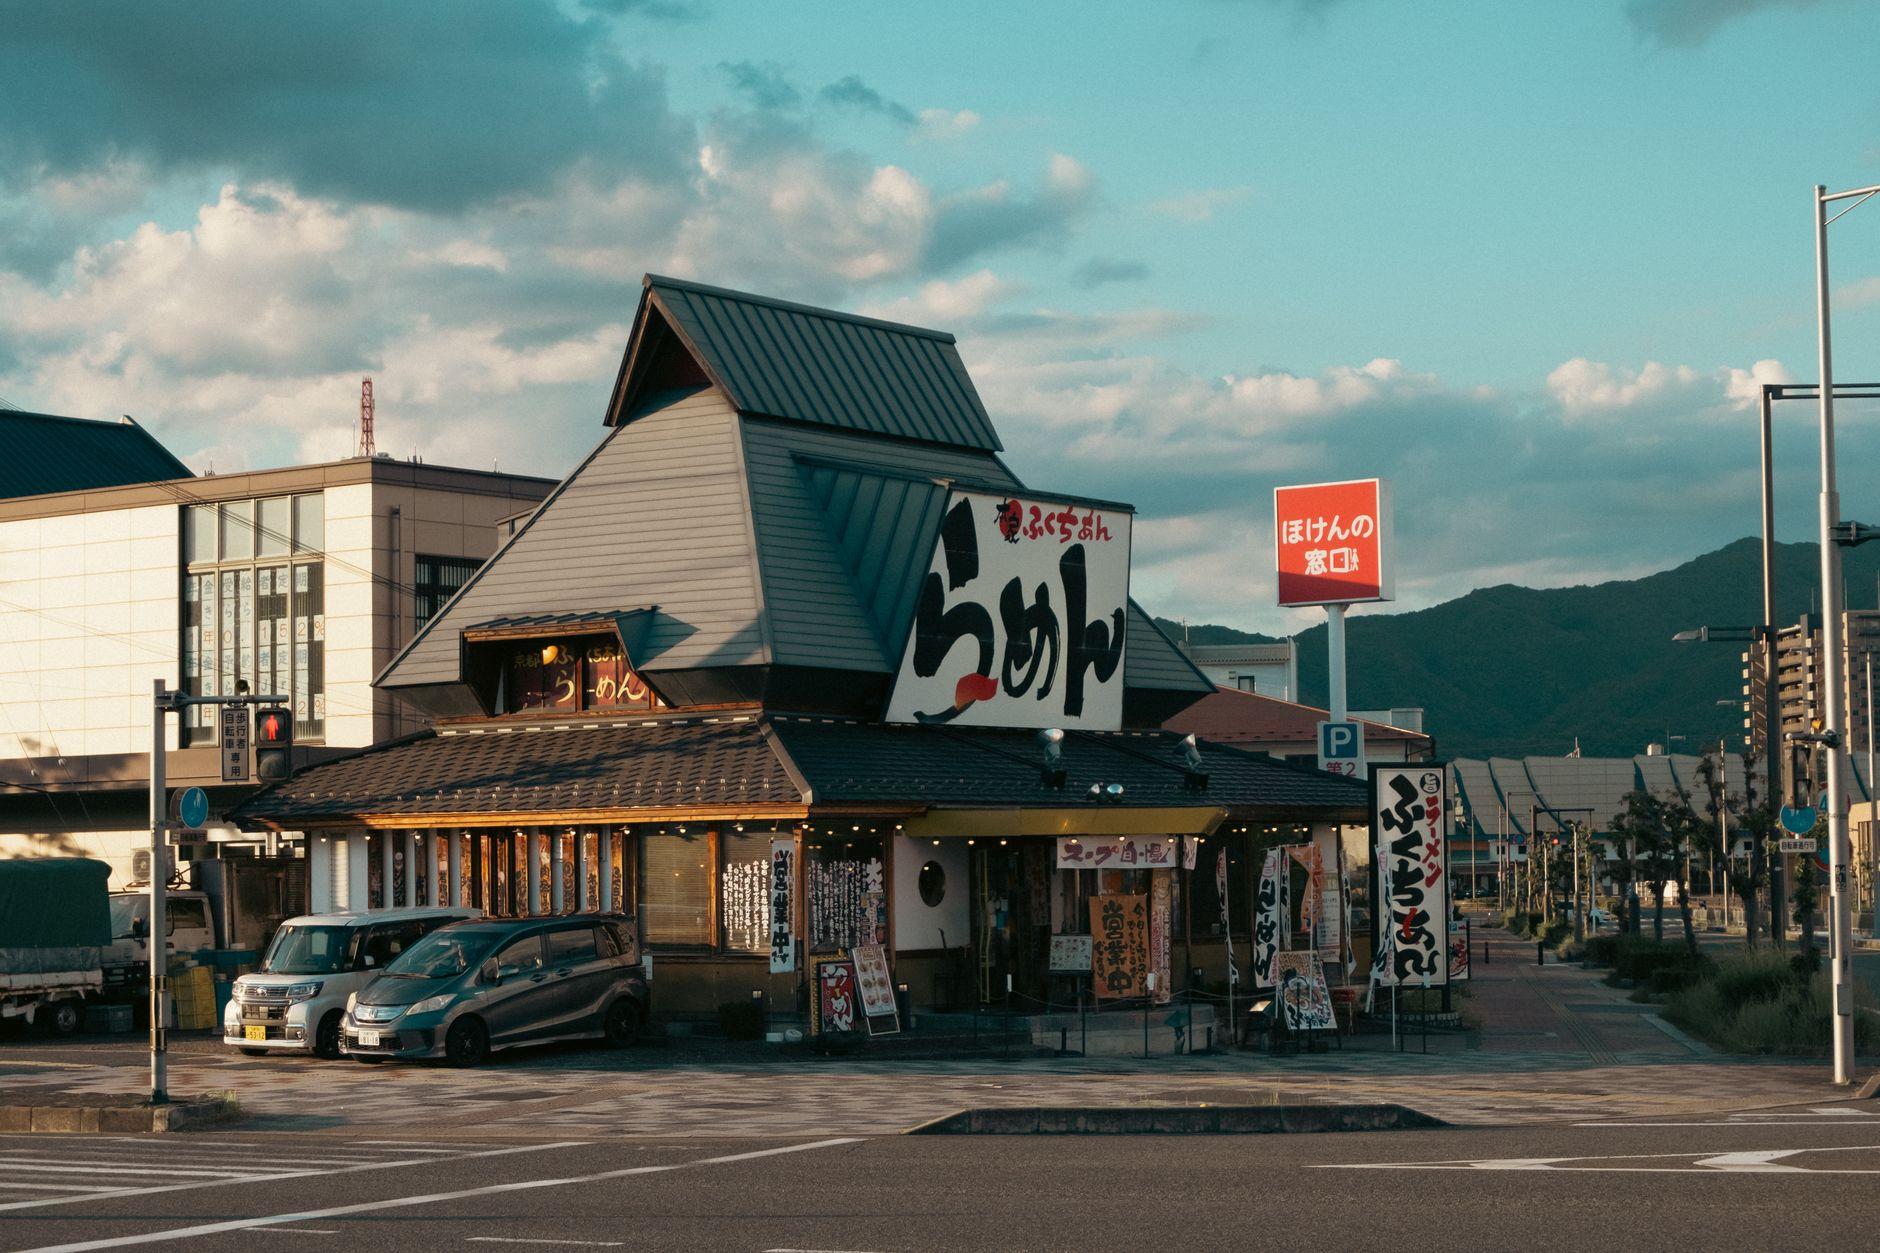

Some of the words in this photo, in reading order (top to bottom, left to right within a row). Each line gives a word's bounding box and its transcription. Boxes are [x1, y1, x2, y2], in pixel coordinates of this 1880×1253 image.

[1282, 513, 1374, 544] ほけんの
[1305, 547, 1352, 576] 窓口
[555, 669, 646, 703] らーめん
[225, 713, 235, 749] 自転車
[236, 713, 246, 749] 歩行者
[1330, 726, 1352, 757] P
[231, 752, 240, 776] 専用
[1423, 795, 1443, 889] ラーメン
[1102, 899, 1132, 994] 営業中
